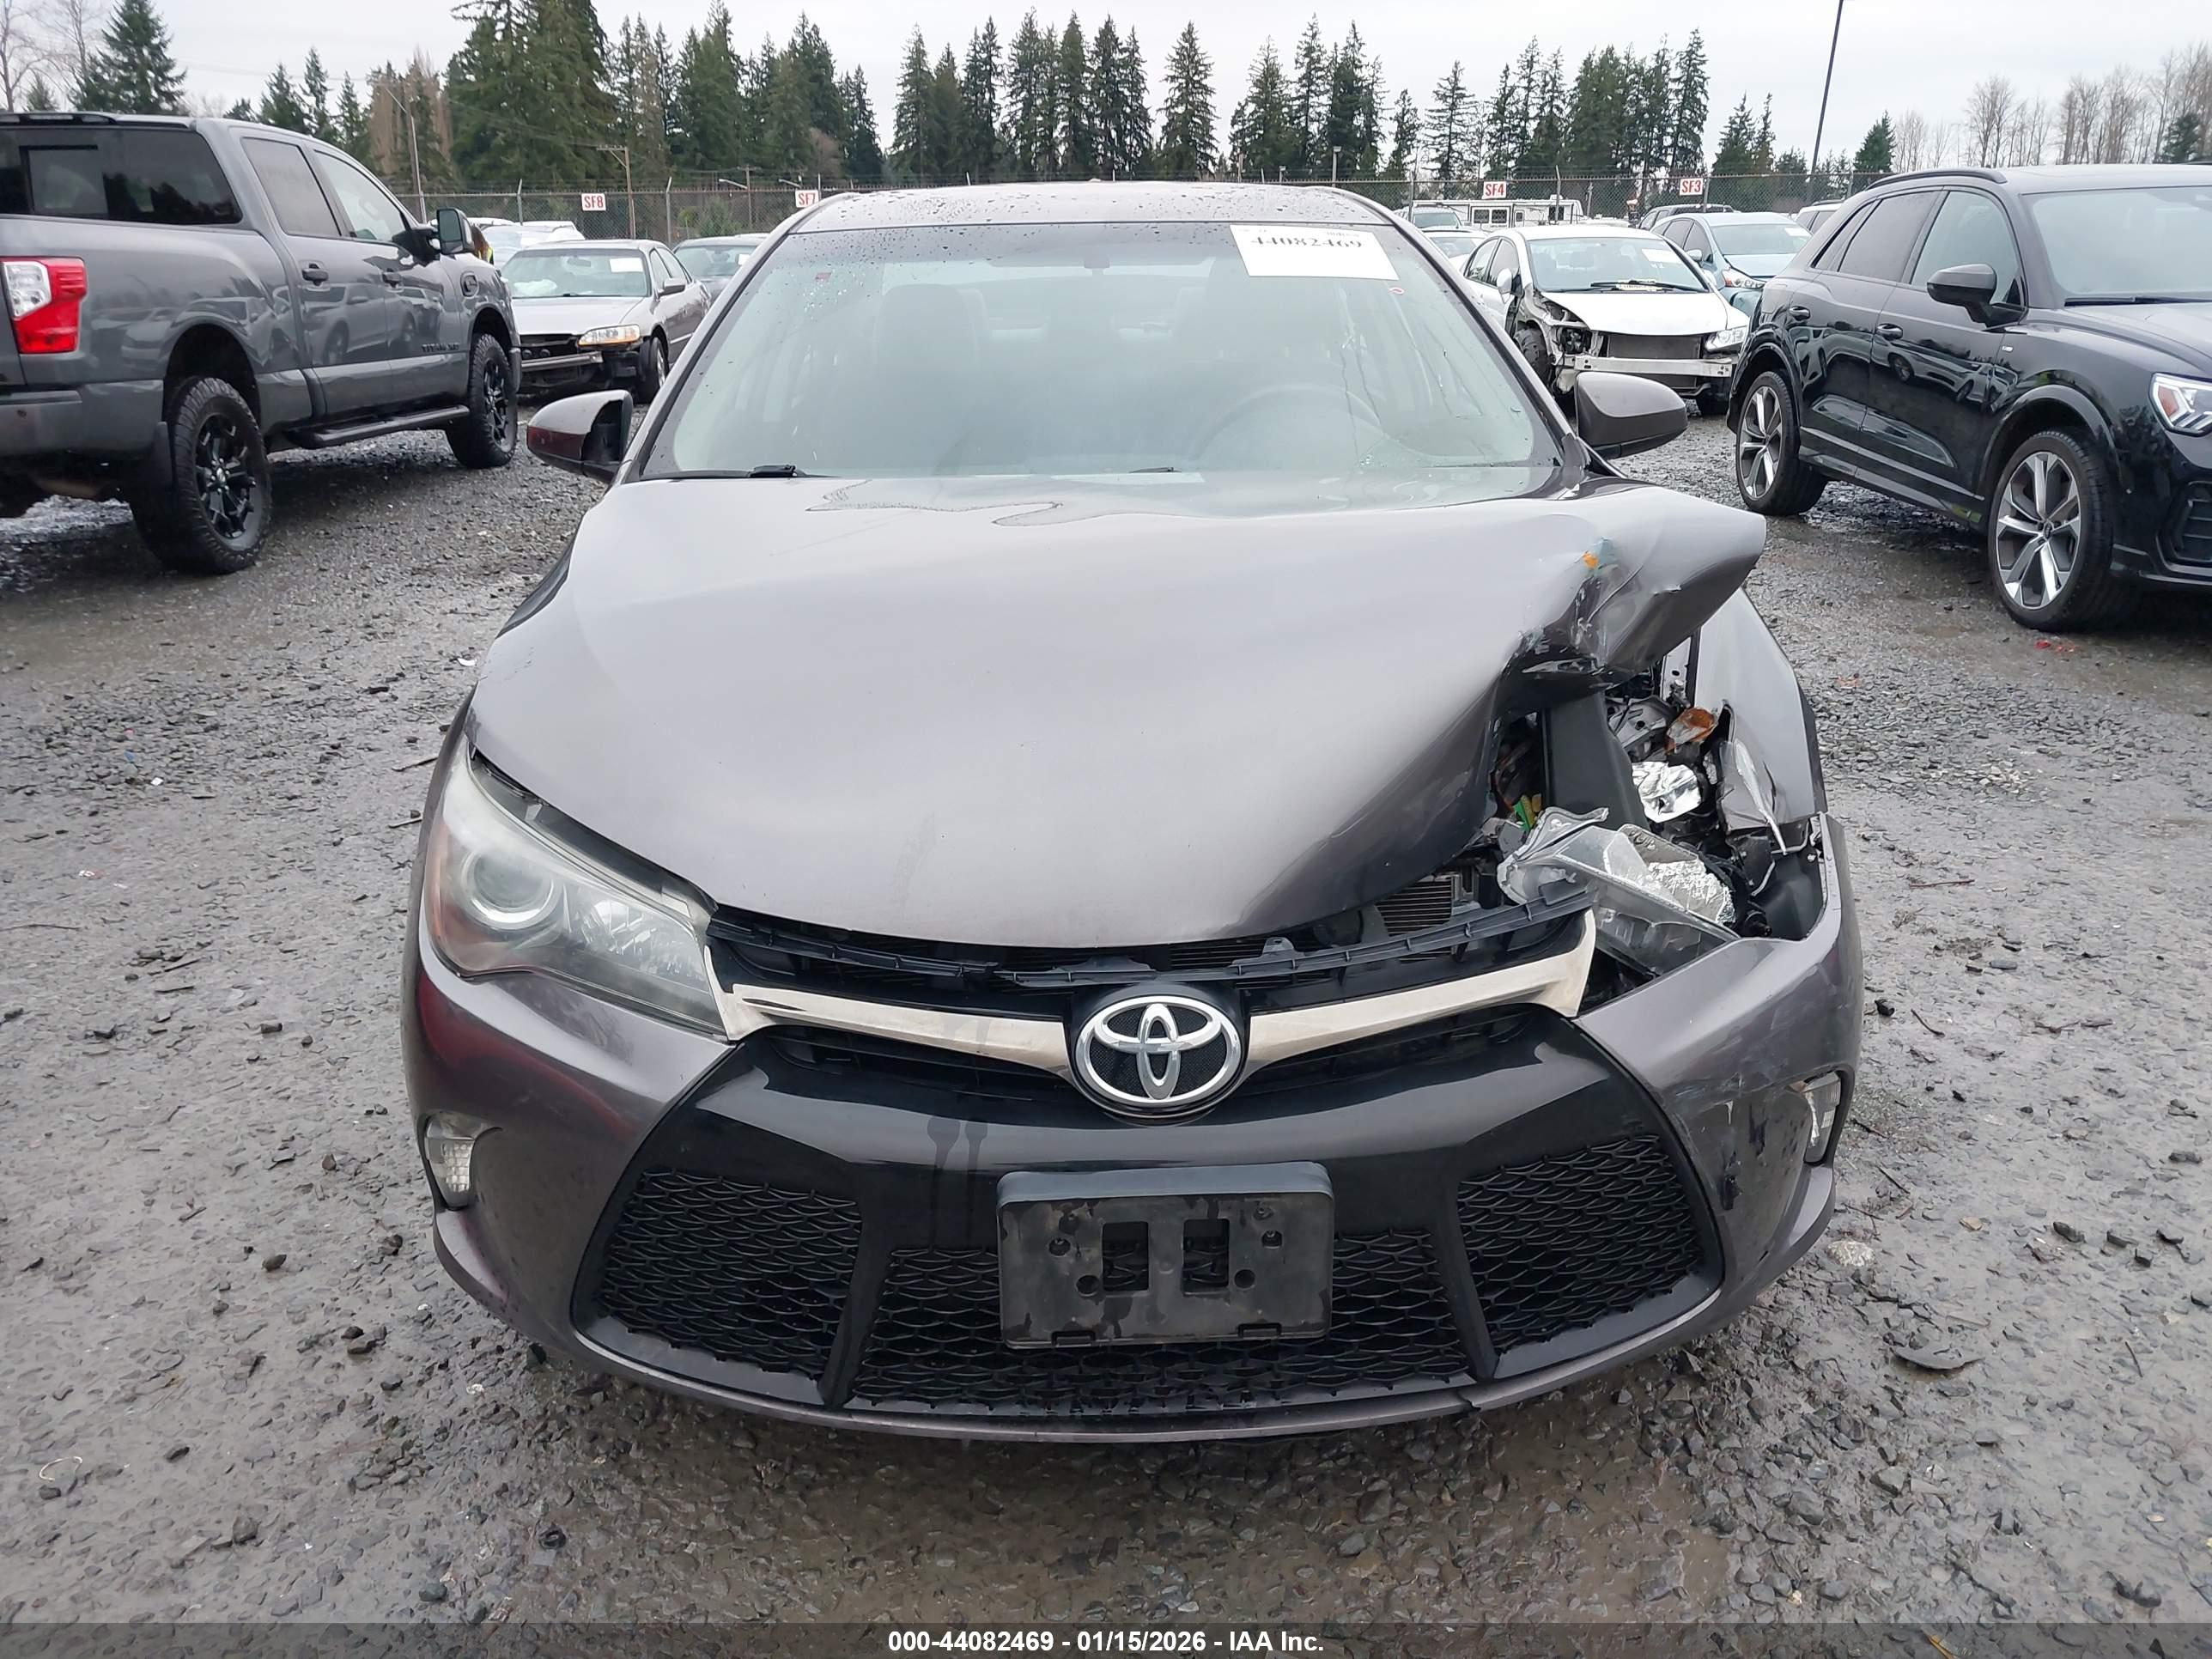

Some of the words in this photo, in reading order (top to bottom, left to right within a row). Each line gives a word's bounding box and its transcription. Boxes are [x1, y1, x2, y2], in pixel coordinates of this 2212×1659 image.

[1486, 184, 1504, 196] SF4
[1682, 180, 1701, 192] SF3
[584, 196, 603, 208] SF8
[799, 192, 815, 205] SF7
